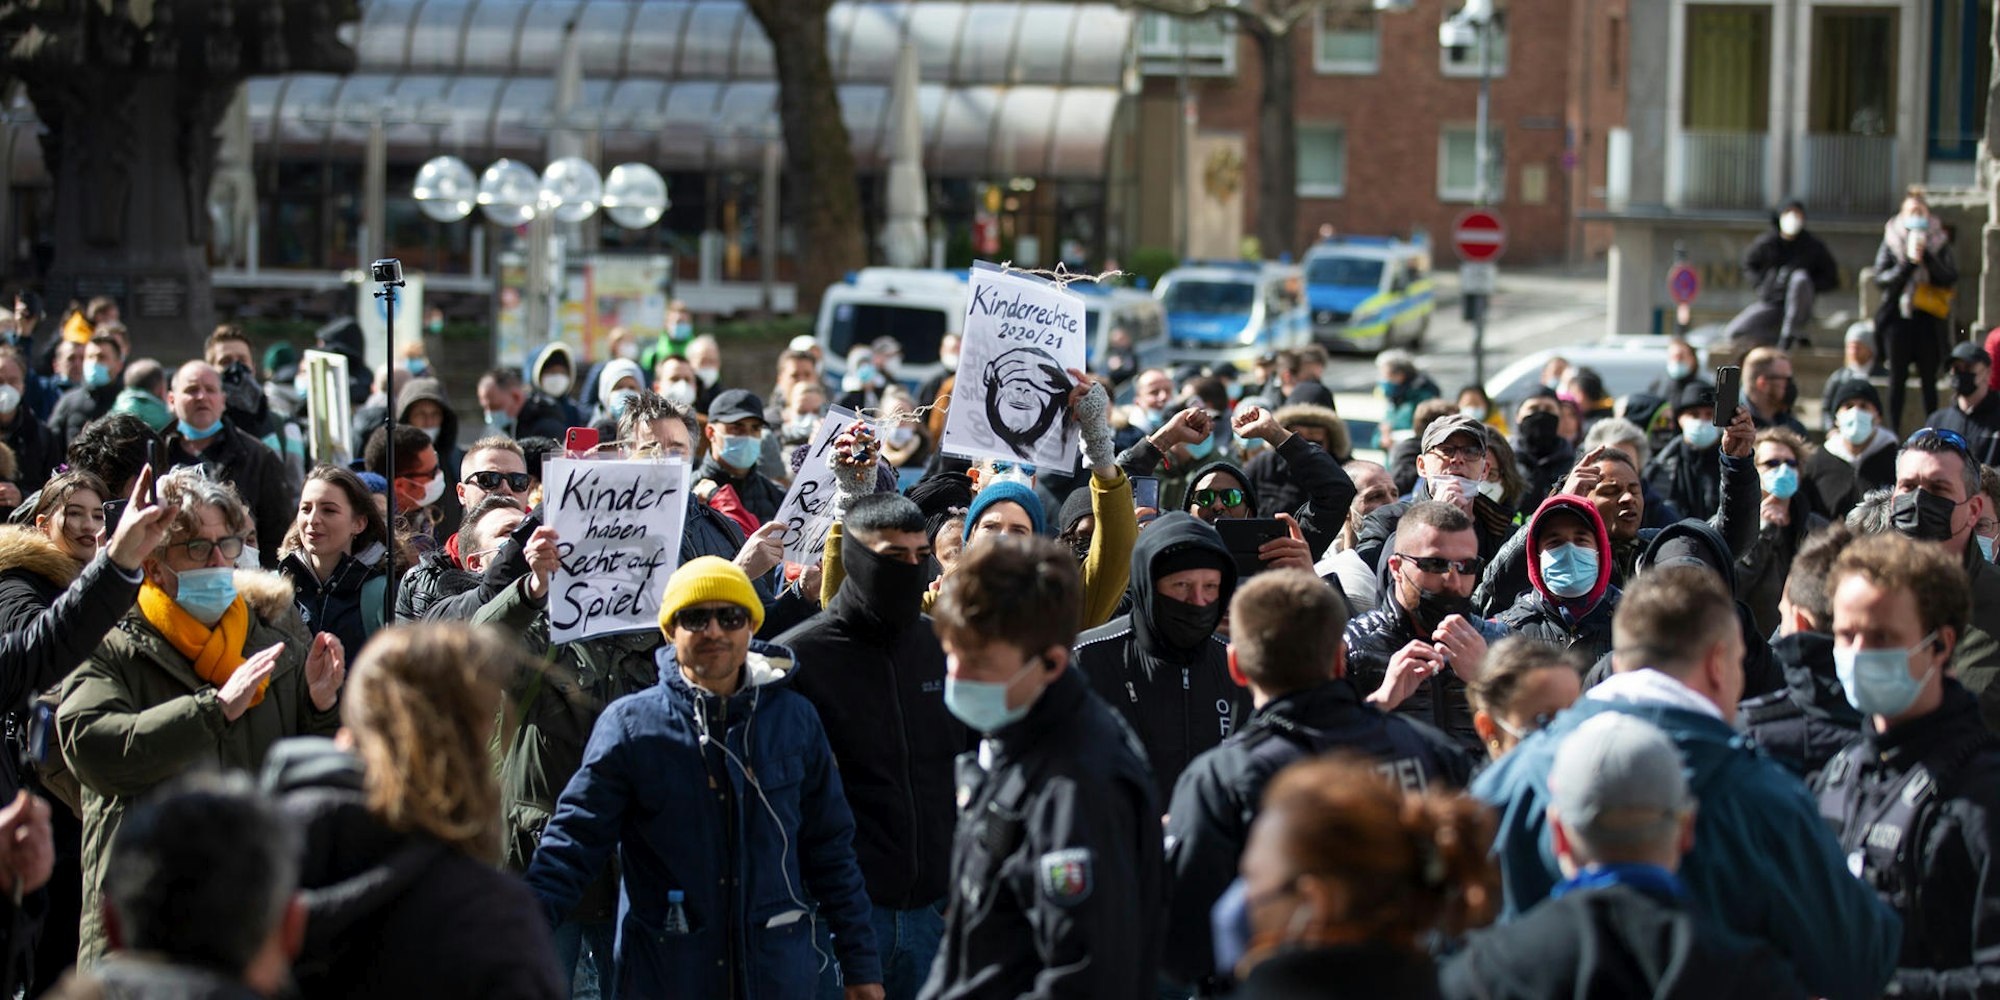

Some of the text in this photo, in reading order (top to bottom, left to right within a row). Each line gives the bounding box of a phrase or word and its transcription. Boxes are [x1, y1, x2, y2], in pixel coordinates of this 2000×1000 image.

[969, 283, 1078, 333] Kinderrechte
[997, 322, 1063, 349] 2020/21
[560, 468, 677, 512] Kinder
[585, 515, 647, 540] haben
[551, 542, 666, 580] Recht auf
[552, 580, 646, 632] Spiel
